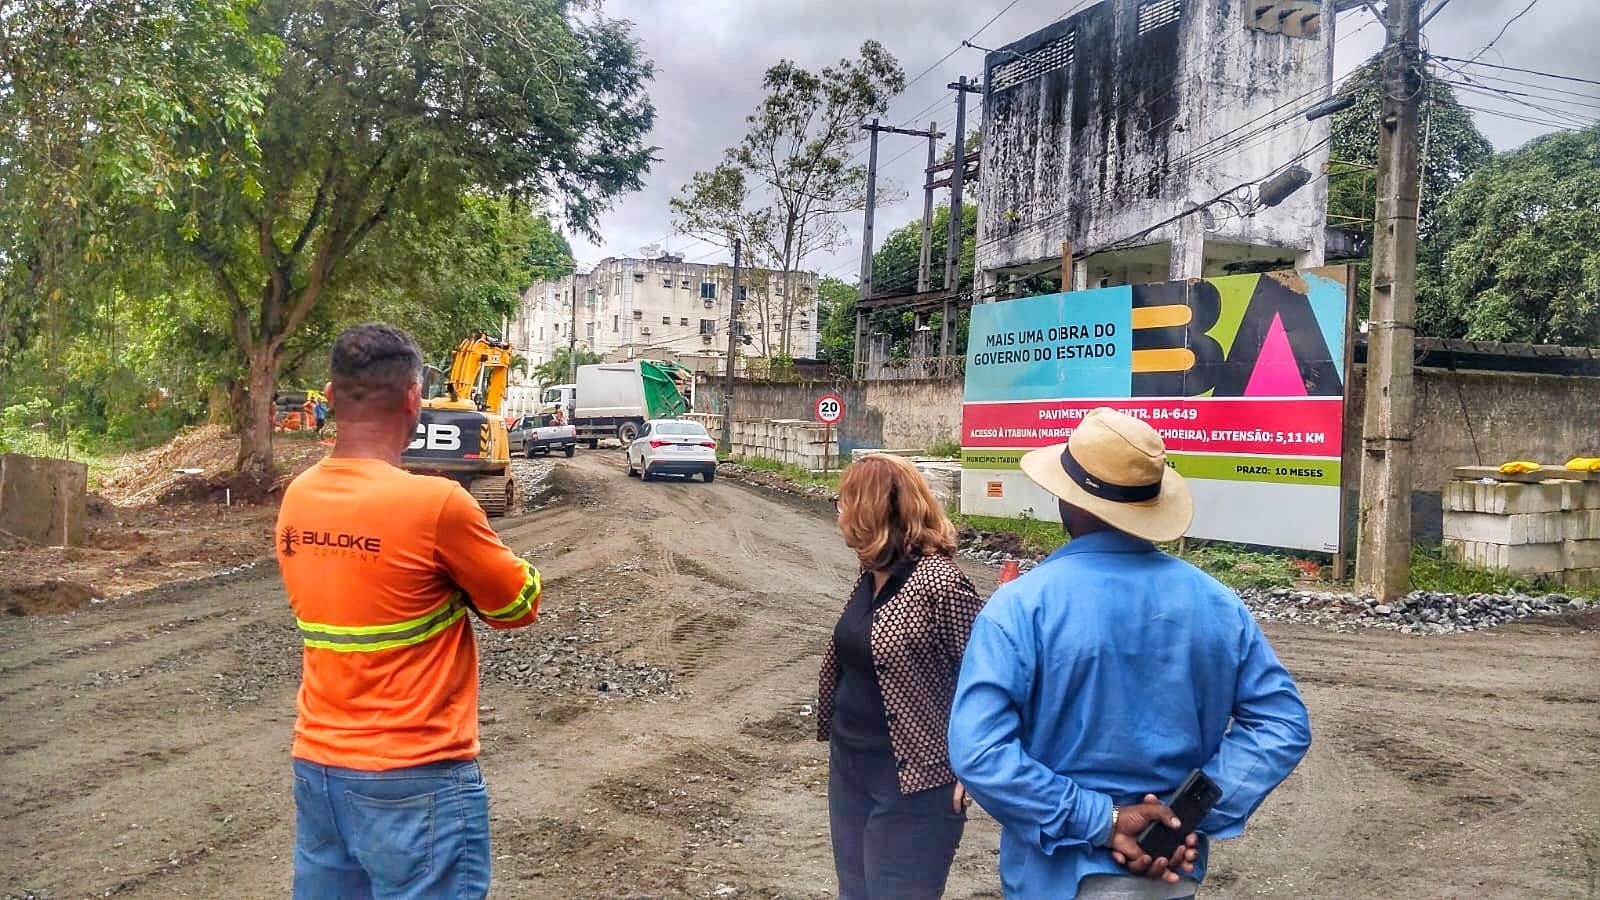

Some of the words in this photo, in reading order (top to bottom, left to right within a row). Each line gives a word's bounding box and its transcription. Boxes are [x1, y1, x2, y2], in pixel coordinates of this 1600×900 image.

[986, 332, 1015, 348] MAIS
[1018, 329, 1044, 344] UMA
[1048, 325, 1090, 341] OBRA
[1094, 322, 1116, 338] DO
[1132, 270, 1343, 396] BA
[974, 349, 1030, 366] GOVERNO
[1034, 347, 1052, 361] DO
[1057, 343, 1116, 360] ESTADO
[821, 402, 838, 412] 20
[1039, 408, 1089, 419] PAVIMENT
[1153, 408, 1198, 419] BA-649
[408, 423, 461, 450] CB
[970, 428, 997, 438] ACESSO
[998, 426, 1004, 438] À
[1005, 428, 1037, 438] ITABUNA
[1155, 428, 1210, 443] CHOEIRA),
[1211, 428, 1274, 442] EXTENSÃO:
[1276, 431, 1302, 445] 5,11
[1305, 432, 1325, 444] KM
[1236, 465, 1271, 475] PRAZO:
[1275, 467, 1287, 476] 10
[1290, 468, 1323, 478] MESES
[302, 531, 381, 553] BULOKE
